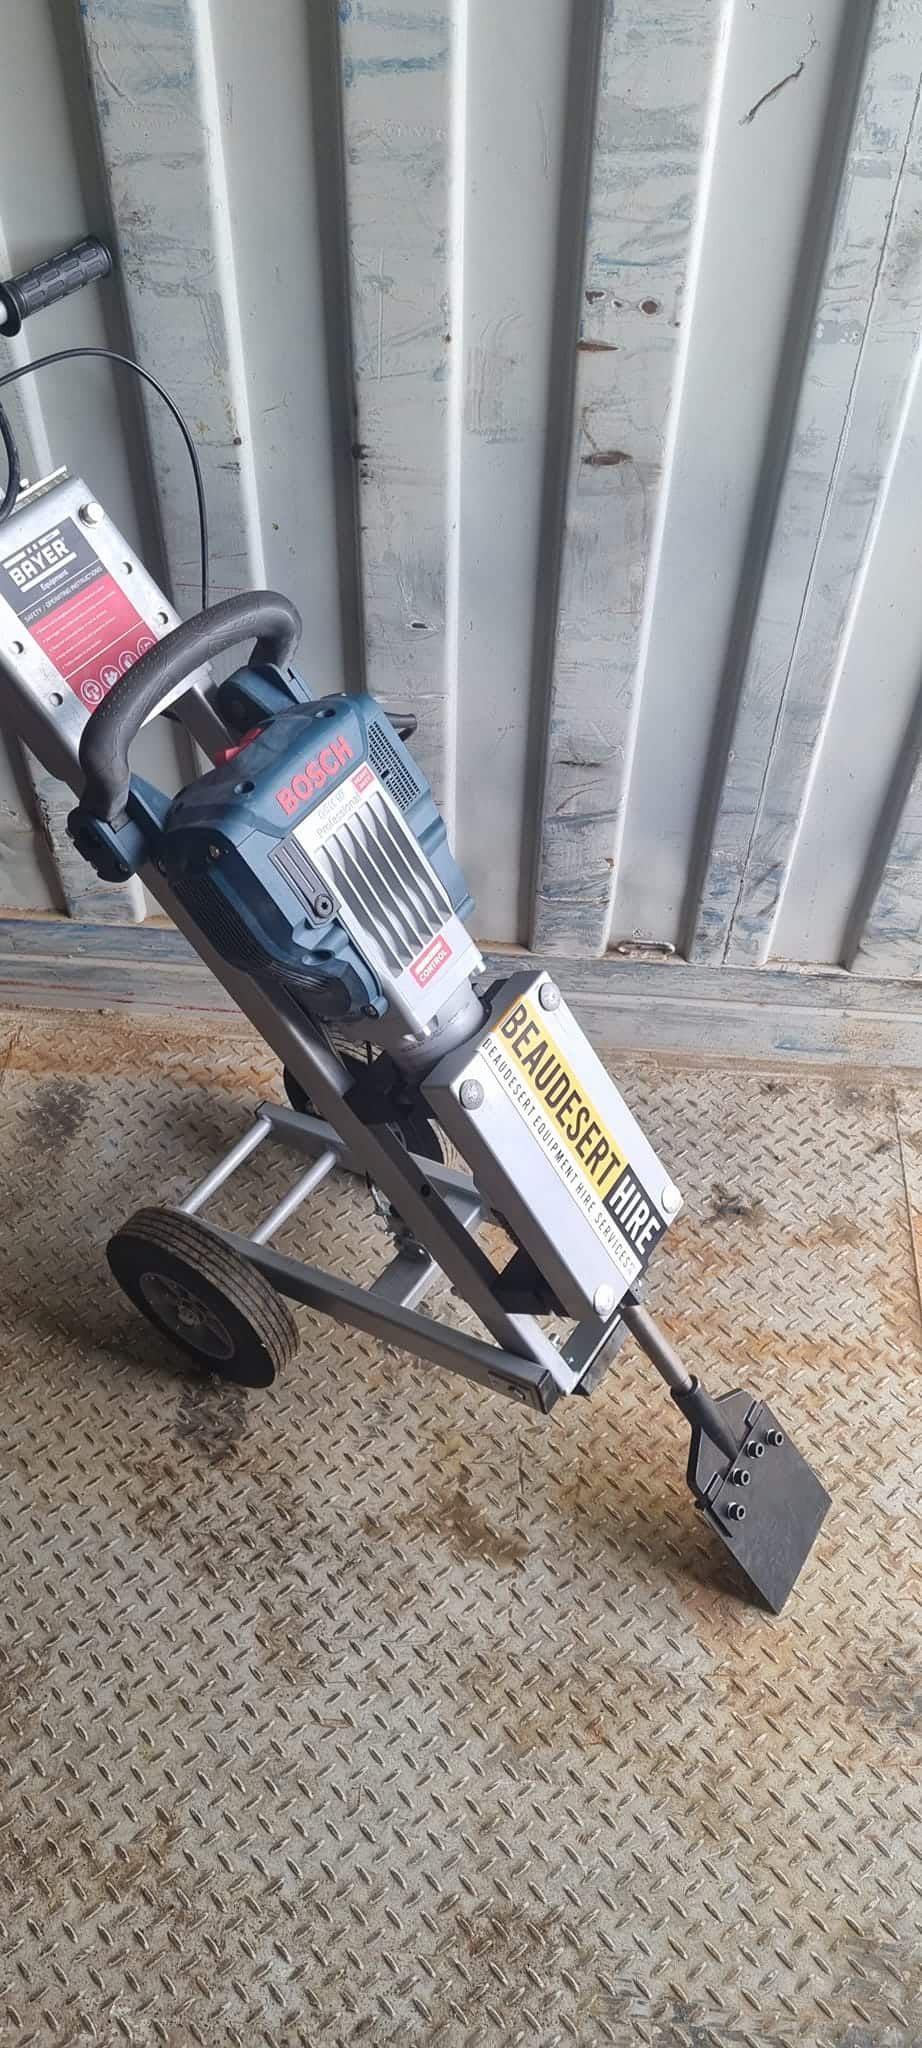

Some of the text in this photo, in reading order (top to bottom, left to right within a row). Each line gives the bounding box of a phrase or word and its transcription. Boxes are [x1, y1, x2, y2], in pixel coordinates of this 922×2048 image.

[39, 568, 70, 592] Equipment
[275, 735, 354, 817] BOSCH
[419, 949, 448, 981] CONTROL
[500, 1003, 661, 1255] BEAUDESERT HIRE
[532, 1114, 579, 1189] EQUIPMENT
[574, 1182, 596, 1213] HIRE
